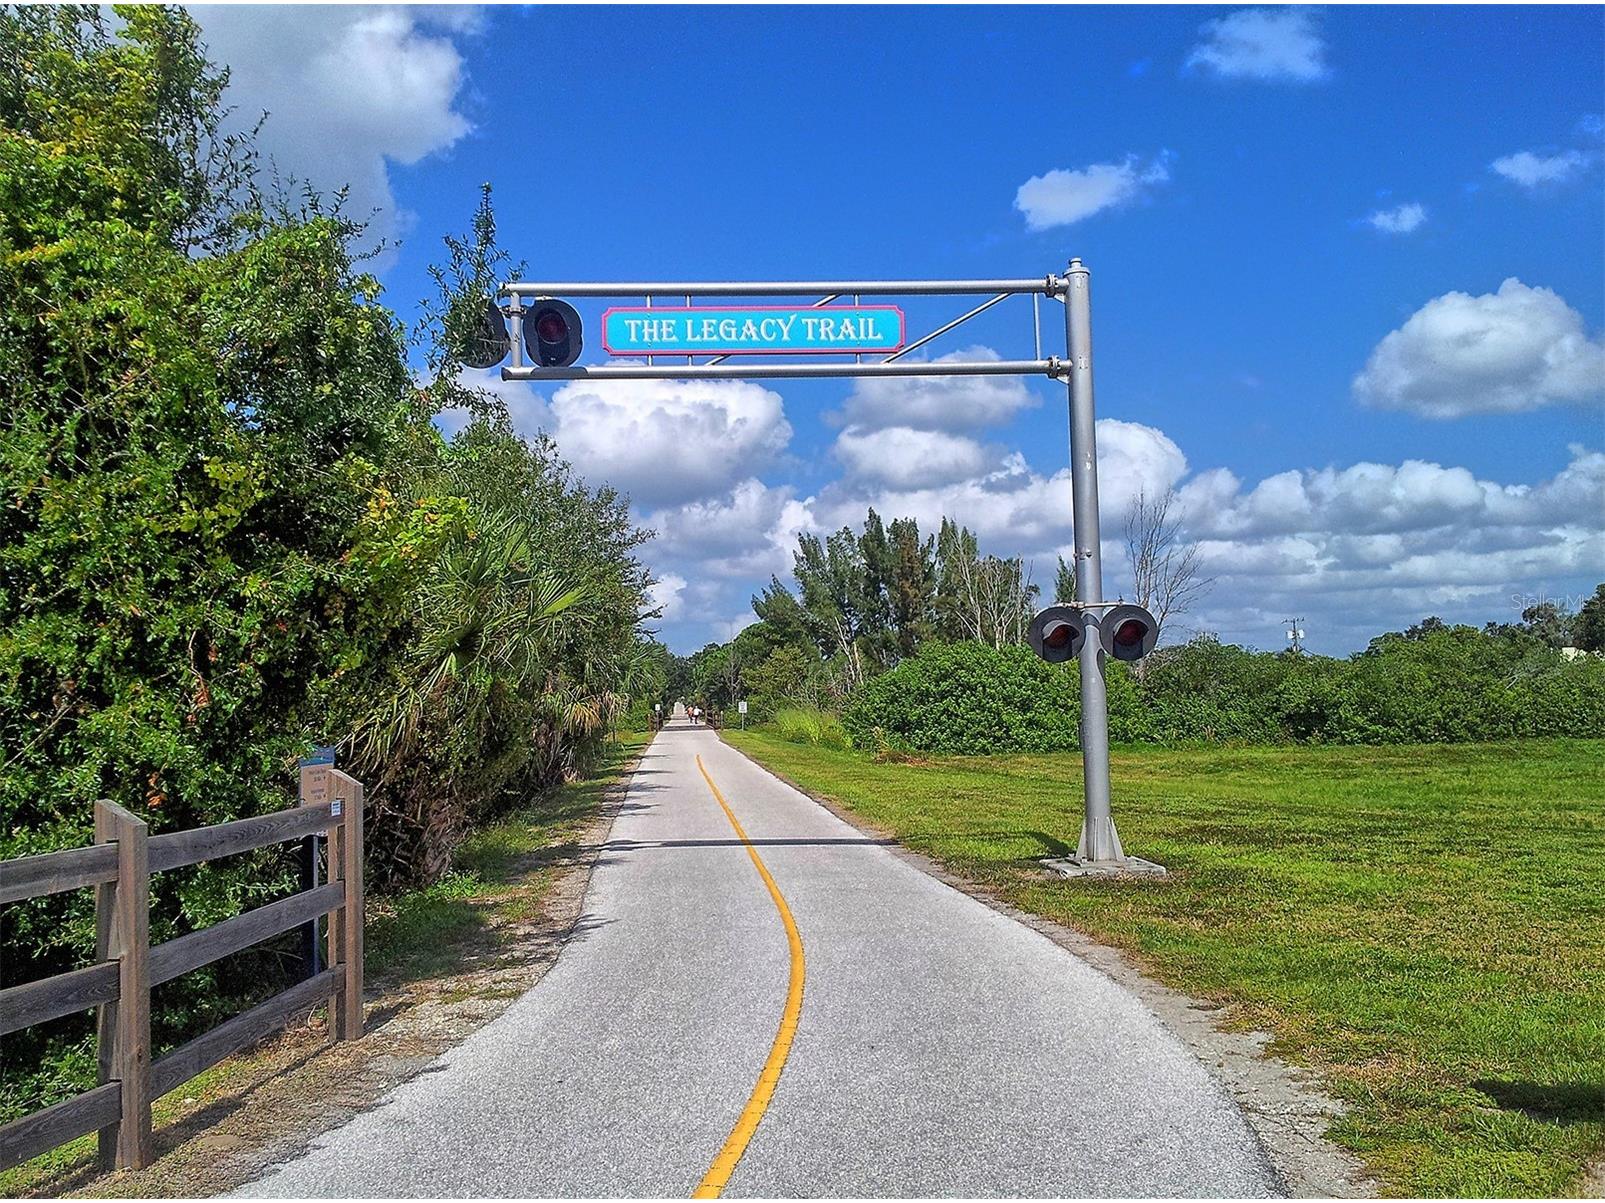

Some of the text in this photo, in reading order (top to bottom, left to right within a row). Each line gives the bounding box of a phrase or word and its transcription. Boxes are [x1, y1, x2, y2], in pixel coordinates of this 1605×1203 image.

[624, 313, 883, 342] THE LEGACY TRAIL
